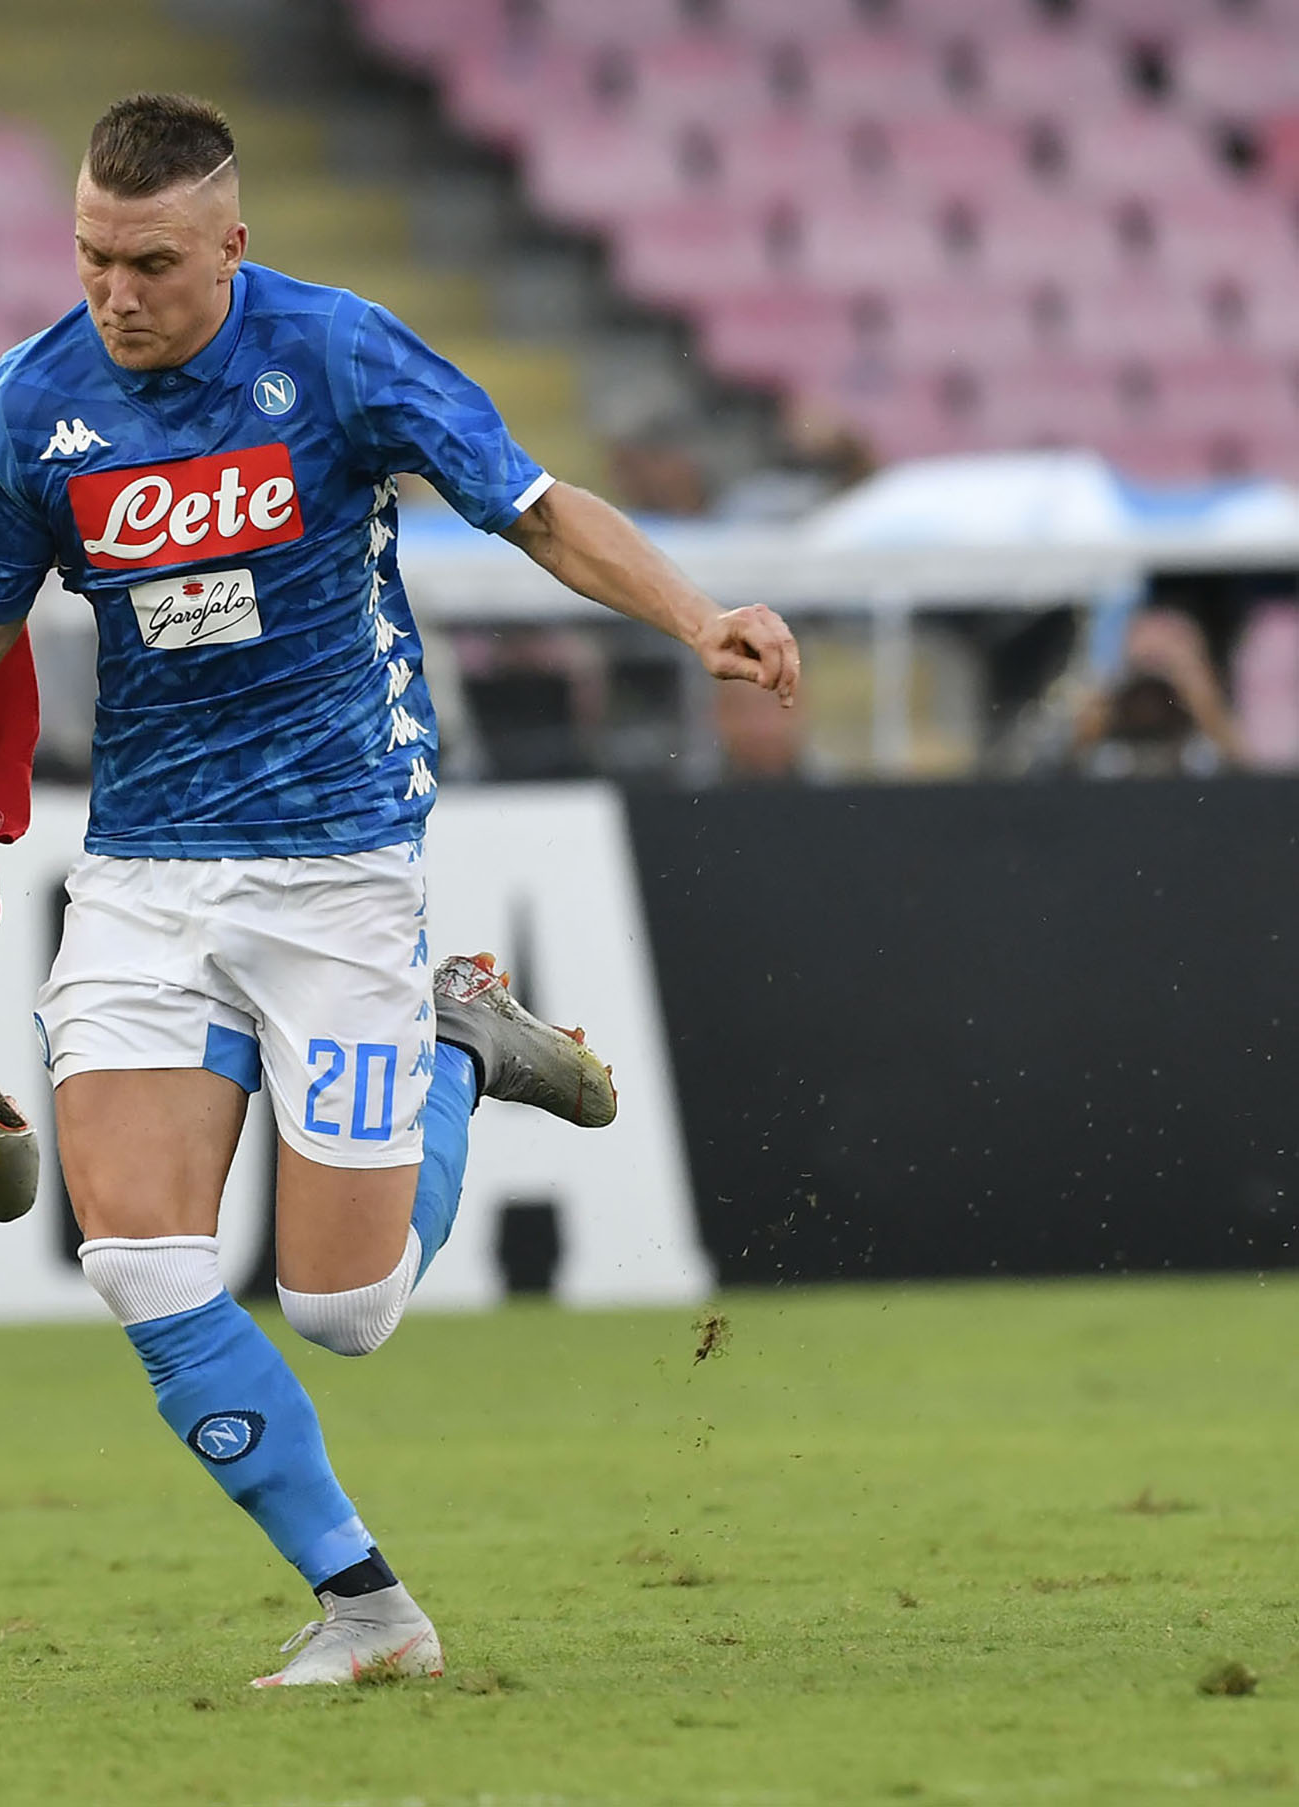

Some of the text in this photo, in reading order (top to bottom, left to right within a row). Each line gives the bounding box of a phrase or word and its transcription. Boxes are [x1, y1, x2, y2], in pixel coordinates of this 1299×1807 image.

[260, 378, 288, 408] N
[83, 467, 295, 560] Lete
[145, 581, 255, 645] Garofalo
[303, 1038, 397, 1141] 20
[203, 1422, 239, 1453] N
